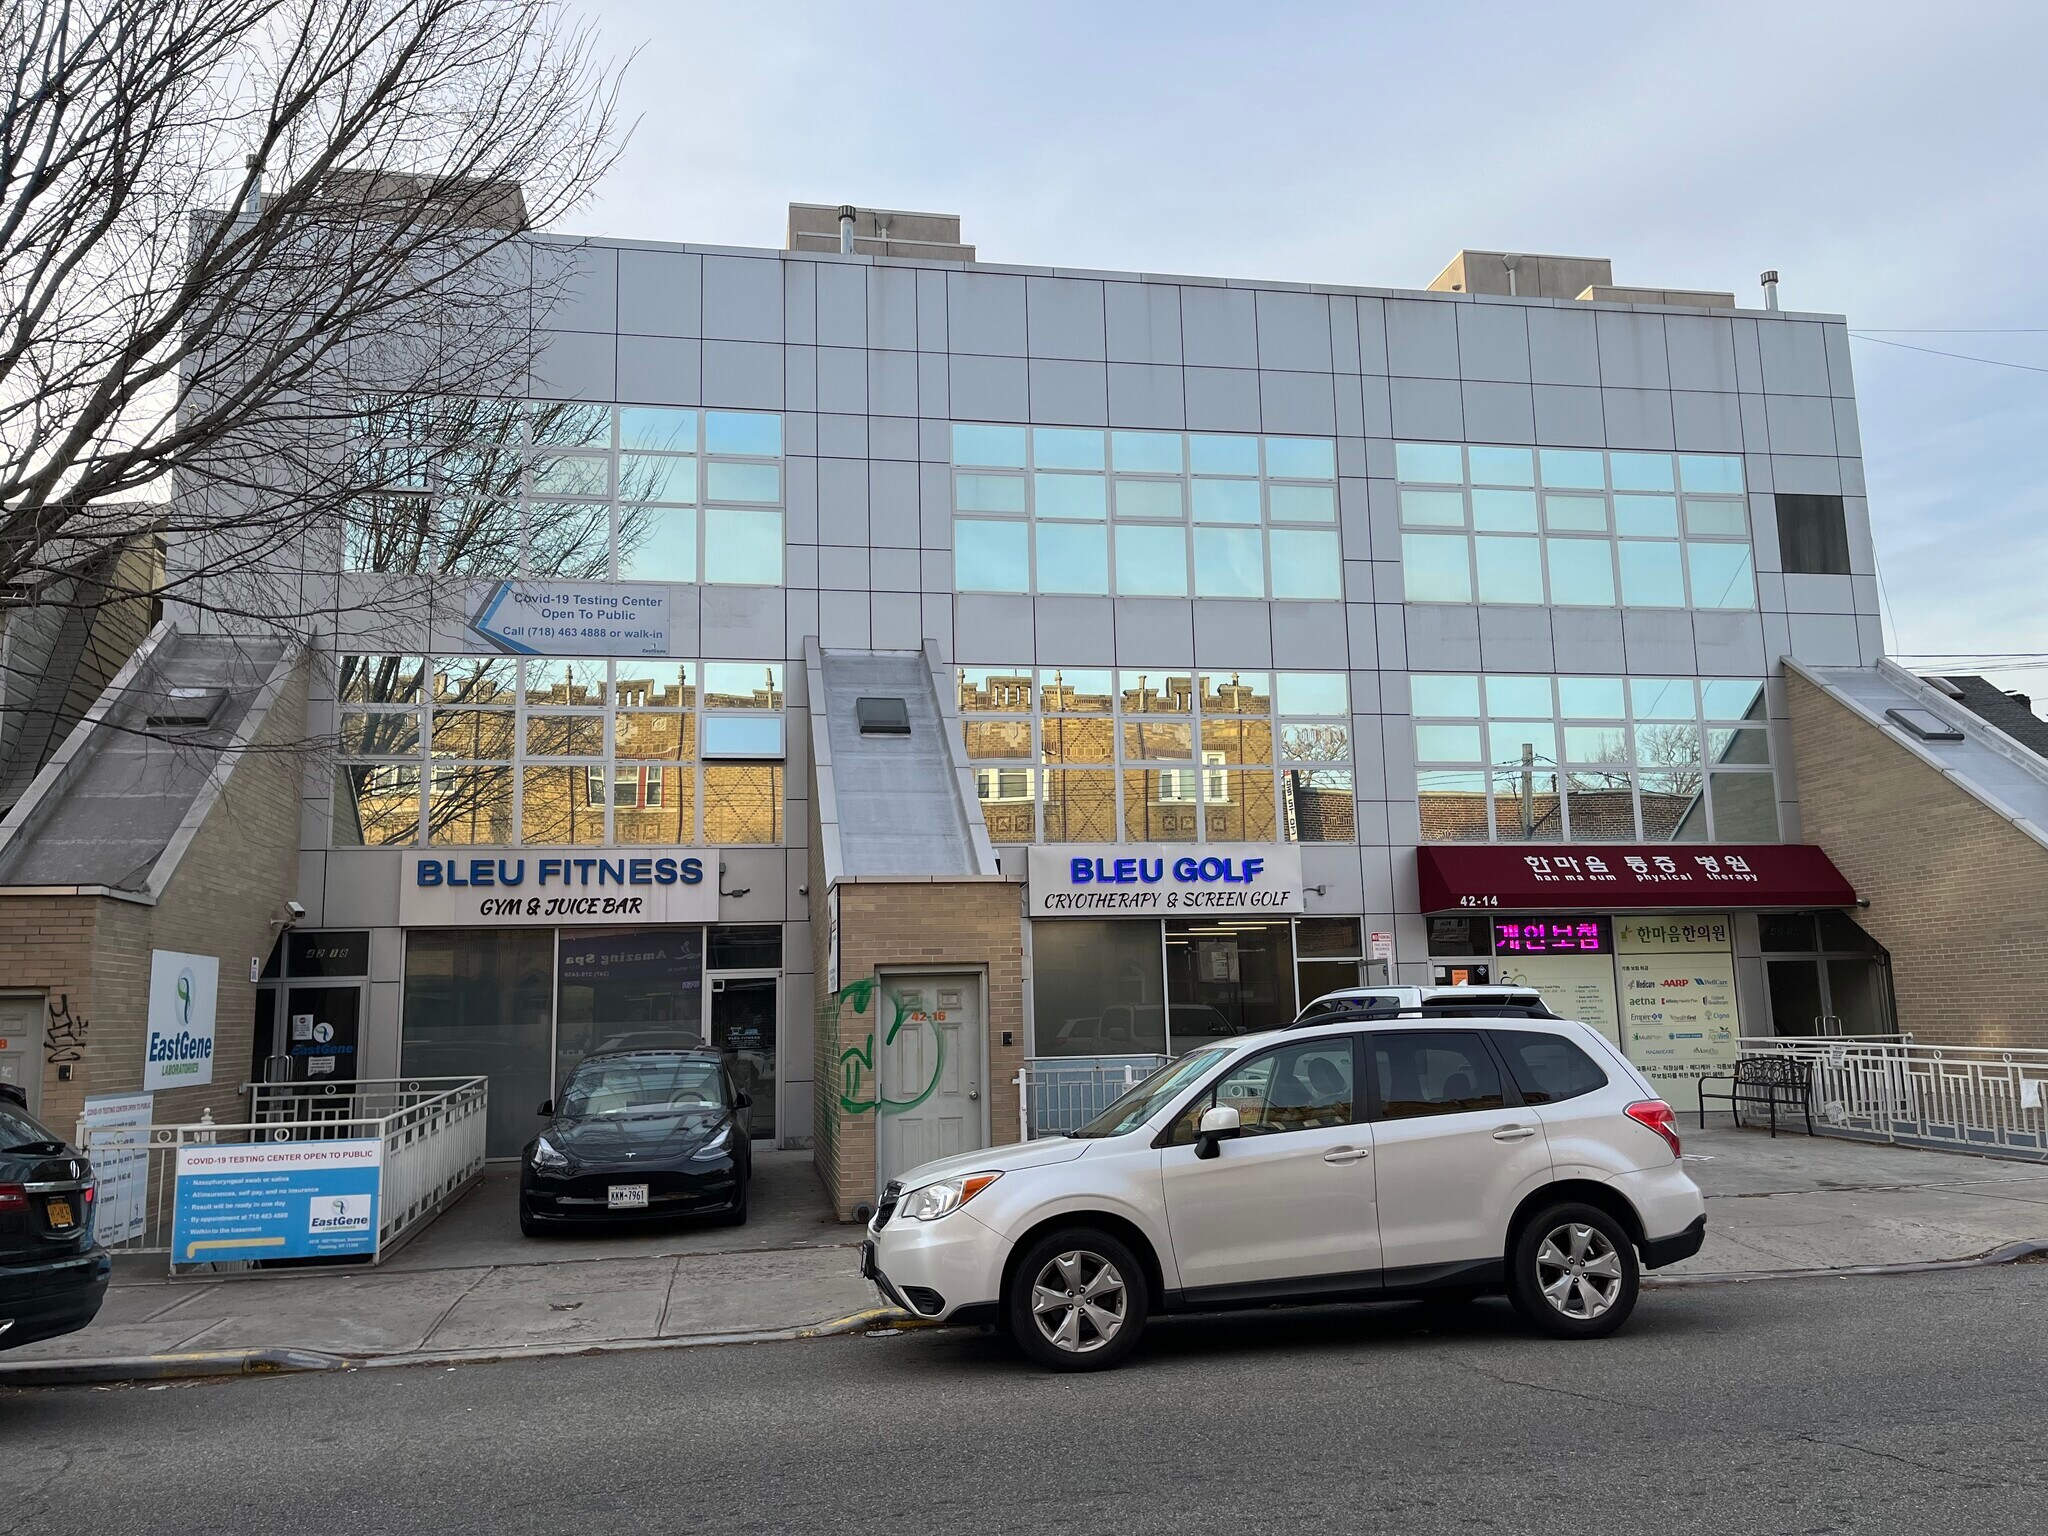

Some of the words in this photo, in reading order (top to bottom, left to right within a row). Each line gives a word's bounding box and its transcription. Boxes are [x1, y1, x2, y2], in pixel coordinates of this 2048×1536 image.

[514, 594, 568, 604] Covid-19
[573, 594, 618, 608] Testing
[622, 595, 662, 606] Center
[541, 608, 574, 620] Open
[578, 609, 594, 618] To
[597, 610, 636, 620] Public
[502, 626, 524, 636] Call
[528, 627, 555, 638] (718)
[558, 628, 578, 636] 463
[580, 628, 606, 638] 4888
[624, 629, 663, 639] walk-in
[1071, 858, 1164, 884] BLEU
[1173, 857, 1264, 884] GOLF
[1524, 855, 1610, 873] 한마음
[1624, 856, 1676, 874] 통증
[1694, 856, 1752, 873] 병원
[416, 859, 525, 886] BLEU
[539, 858, 703, 886] FITNESS
[1534, 874, 1560, 882] han
[1636, 873, 1692, 882] physical
[1706, 873, 1758, 882] therapy
[1044, 892, 1162, 909] CRYOTHERAPY
[1166, 892, 1179, 908] &
[1183, 891, 1249, 908] SCREEN
[1250, 890, 1291, 906] GOLF
[1460, 896, 1498, 906] 42-14
[480, 898, 522, 916] GYM
[527, 898, 541, 916] &
[545, 898, 600, 916] JUICE
[602, 897, 643, 914] BAR
[1637, 924, 1726, 944] 한마음한의원
[911, 1012, 946, 1021] 42-16
[1630, 1013, 1652, 1022] Empire
[149, 1030, 212, 1062] EastGene
[291, 1044, 353, 1056] EastGene
[161, 1062, 199, 1077] LABORATORIES
[187, 1157, 226, 1165] COVID-19
[229, 1155, 265, 1163] TESTING
[192, 1178, 244, 1186] Nasopharyngeal
[312, 1216, 368, 1227] EastGene
